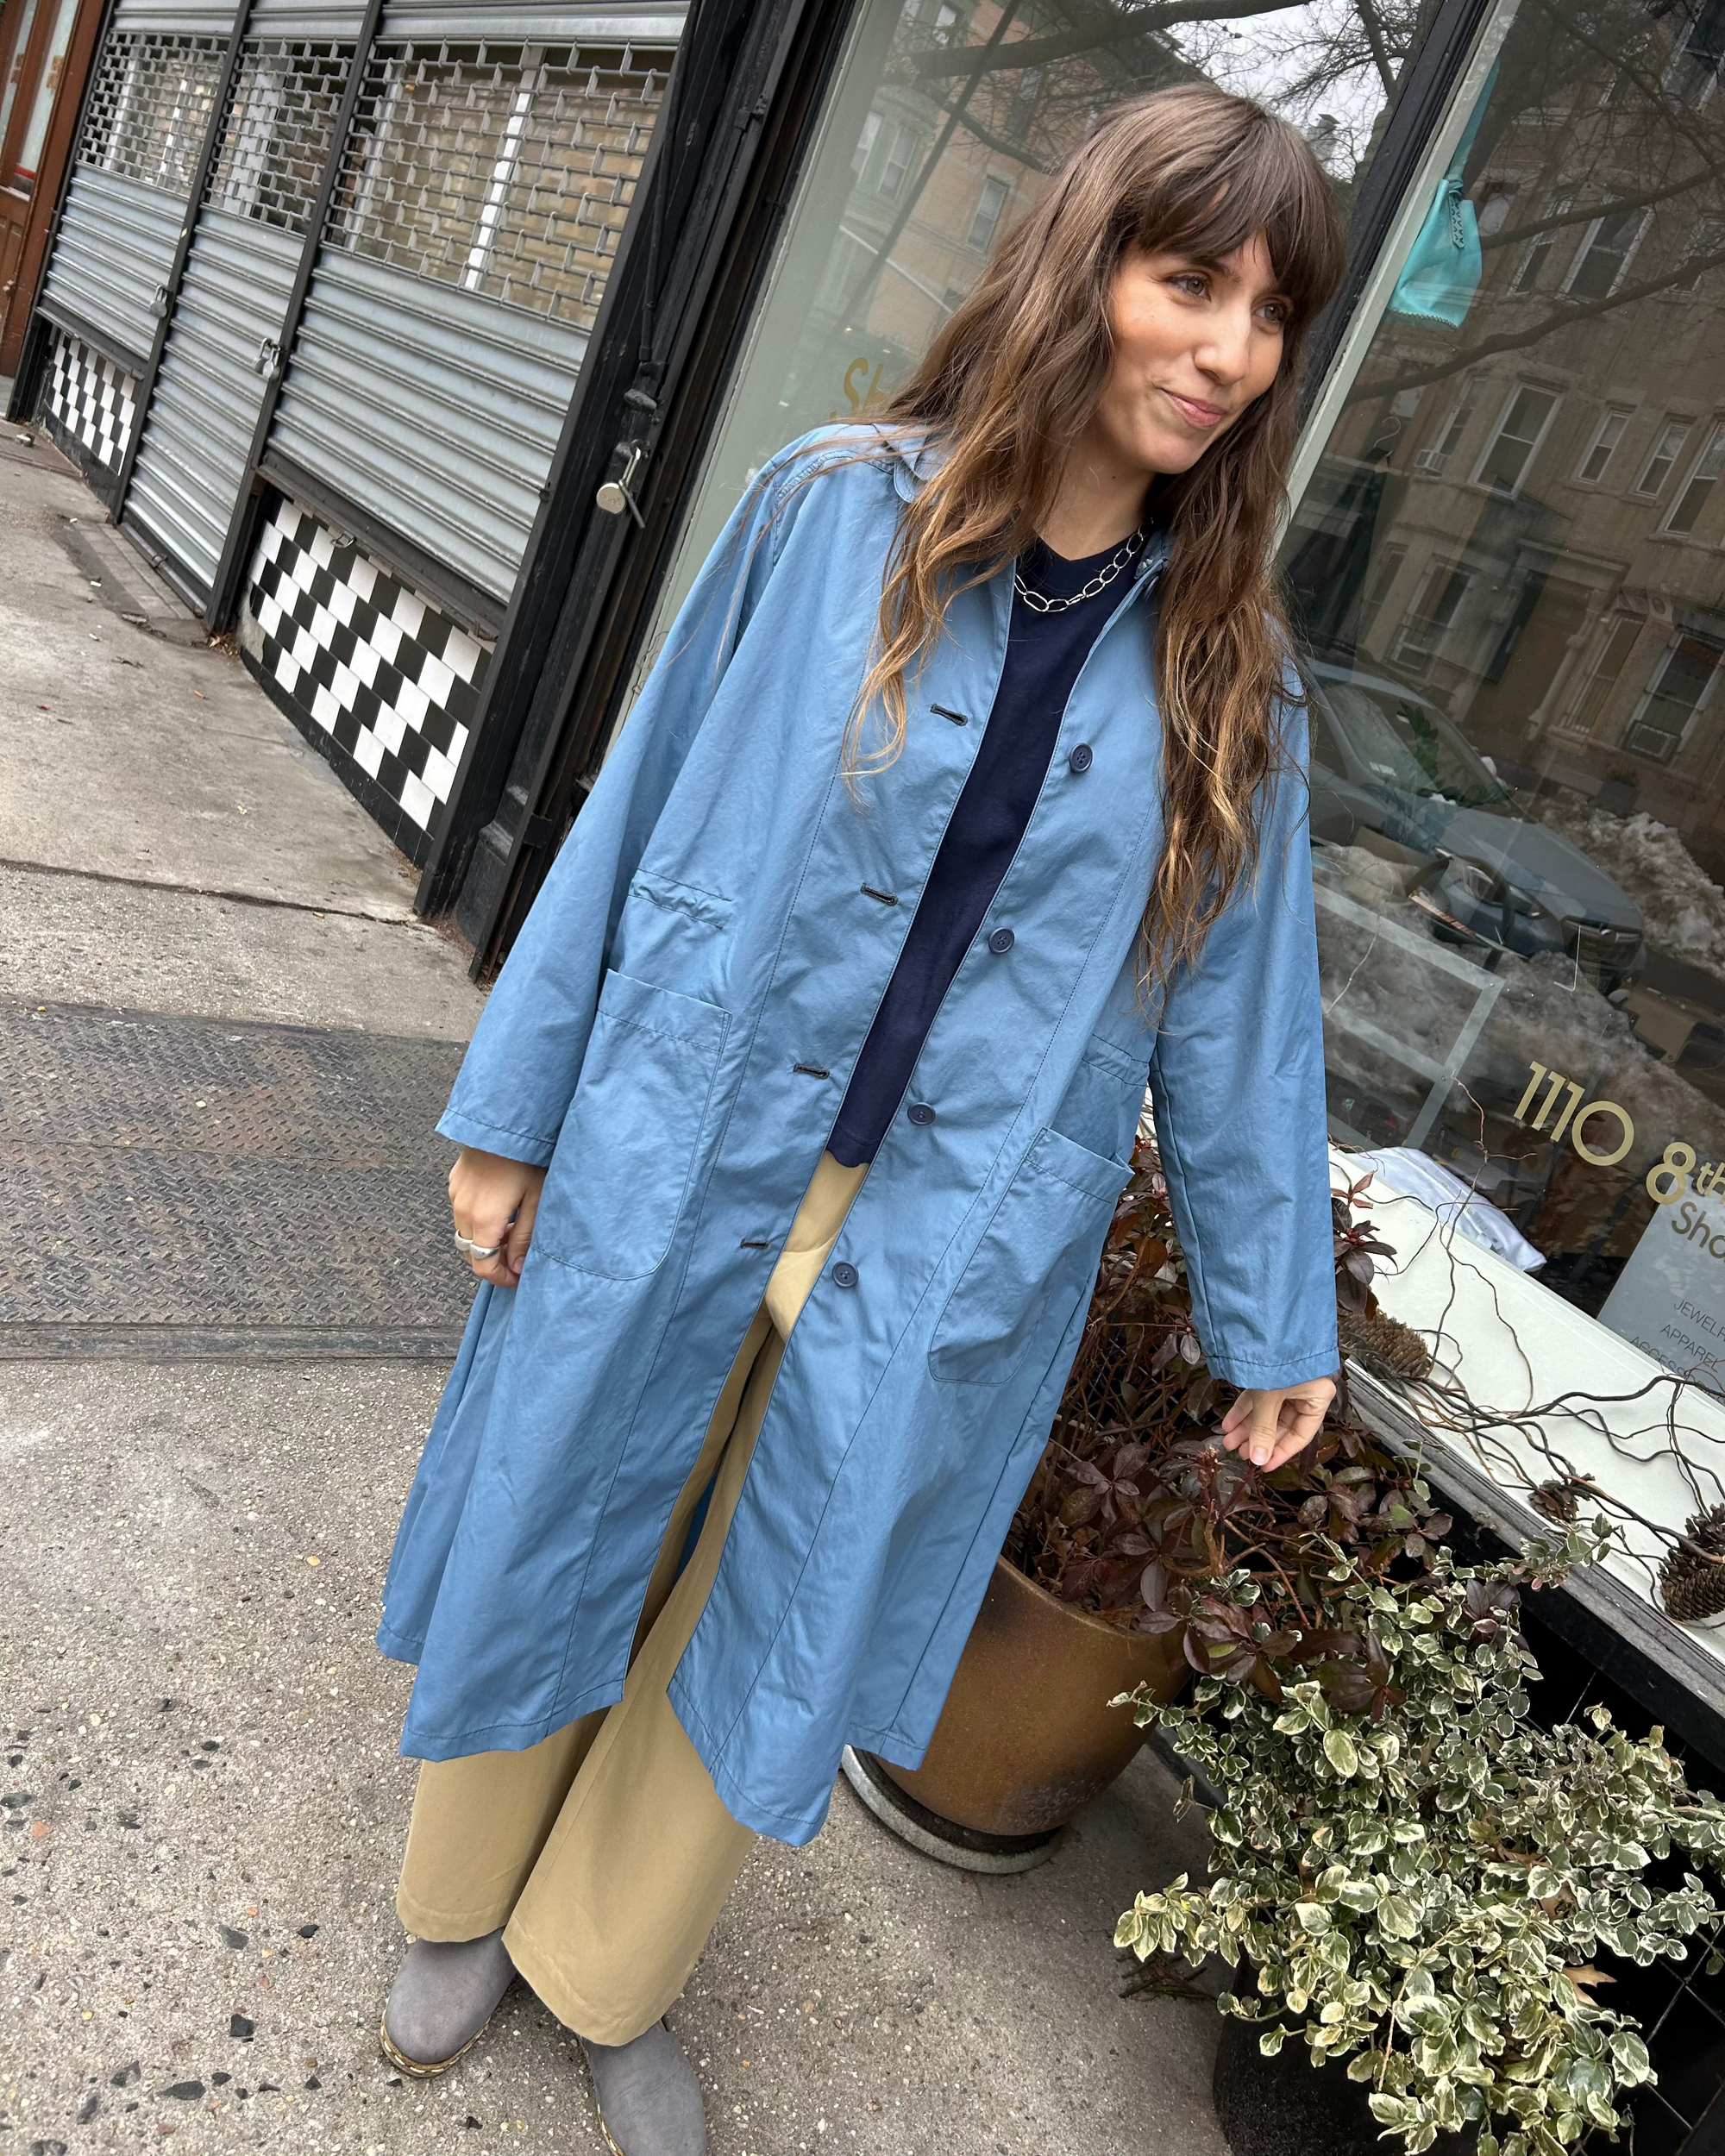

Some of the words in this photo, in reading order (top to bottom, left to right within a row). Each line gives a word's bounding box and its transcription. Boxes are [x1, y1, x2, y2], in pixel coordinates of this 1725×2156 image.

[1514, 1060, 1634, 1167] 1110
[1646, 1141, 1725, 1205] 8th
[1660, 1324, 1719, 1373] APPAREL
